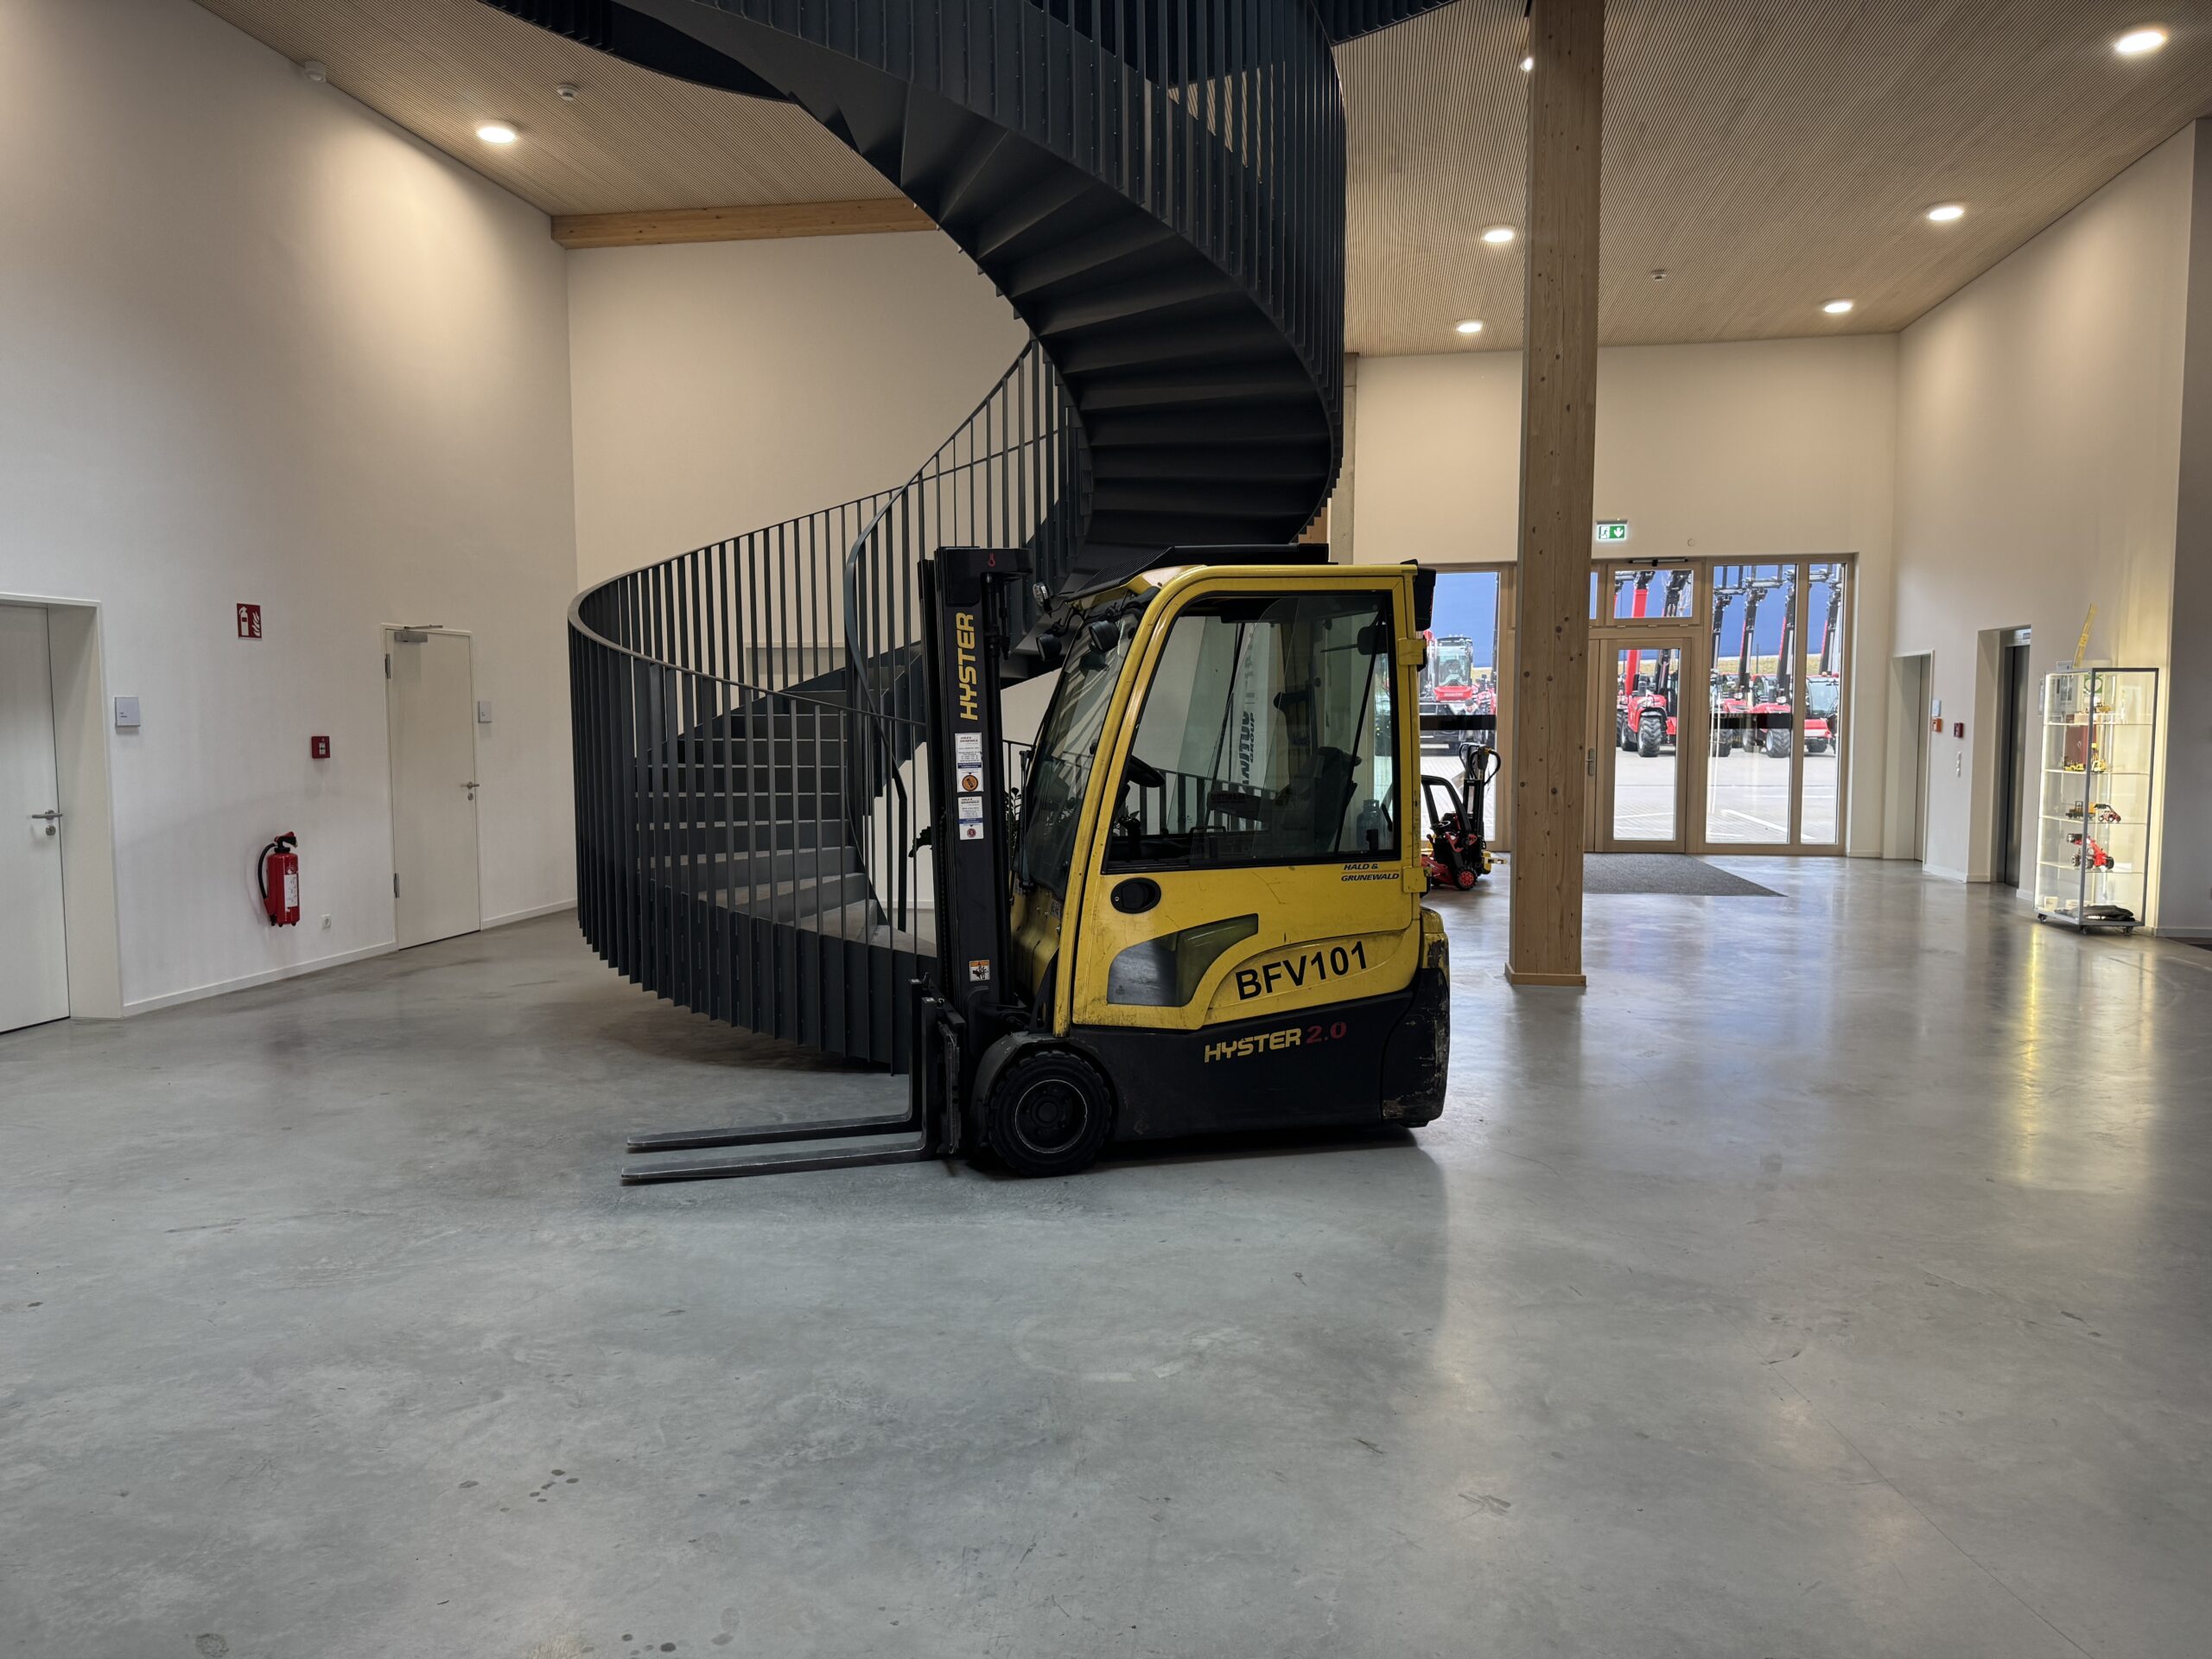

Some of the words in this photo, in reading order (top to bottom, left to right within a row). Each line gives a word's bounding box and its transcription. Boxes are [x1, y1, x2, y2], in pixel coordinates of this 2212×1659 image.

[956, 612, 978, 721] HYSTER
[1341, 873, 1400, 881] GRUNEWALD
[1236, 940, 1367, 1001] BFV101
[1204, 1027, 1302, 1063] HYSTER
[1306, 1021, 1347, 1045] 2.0
